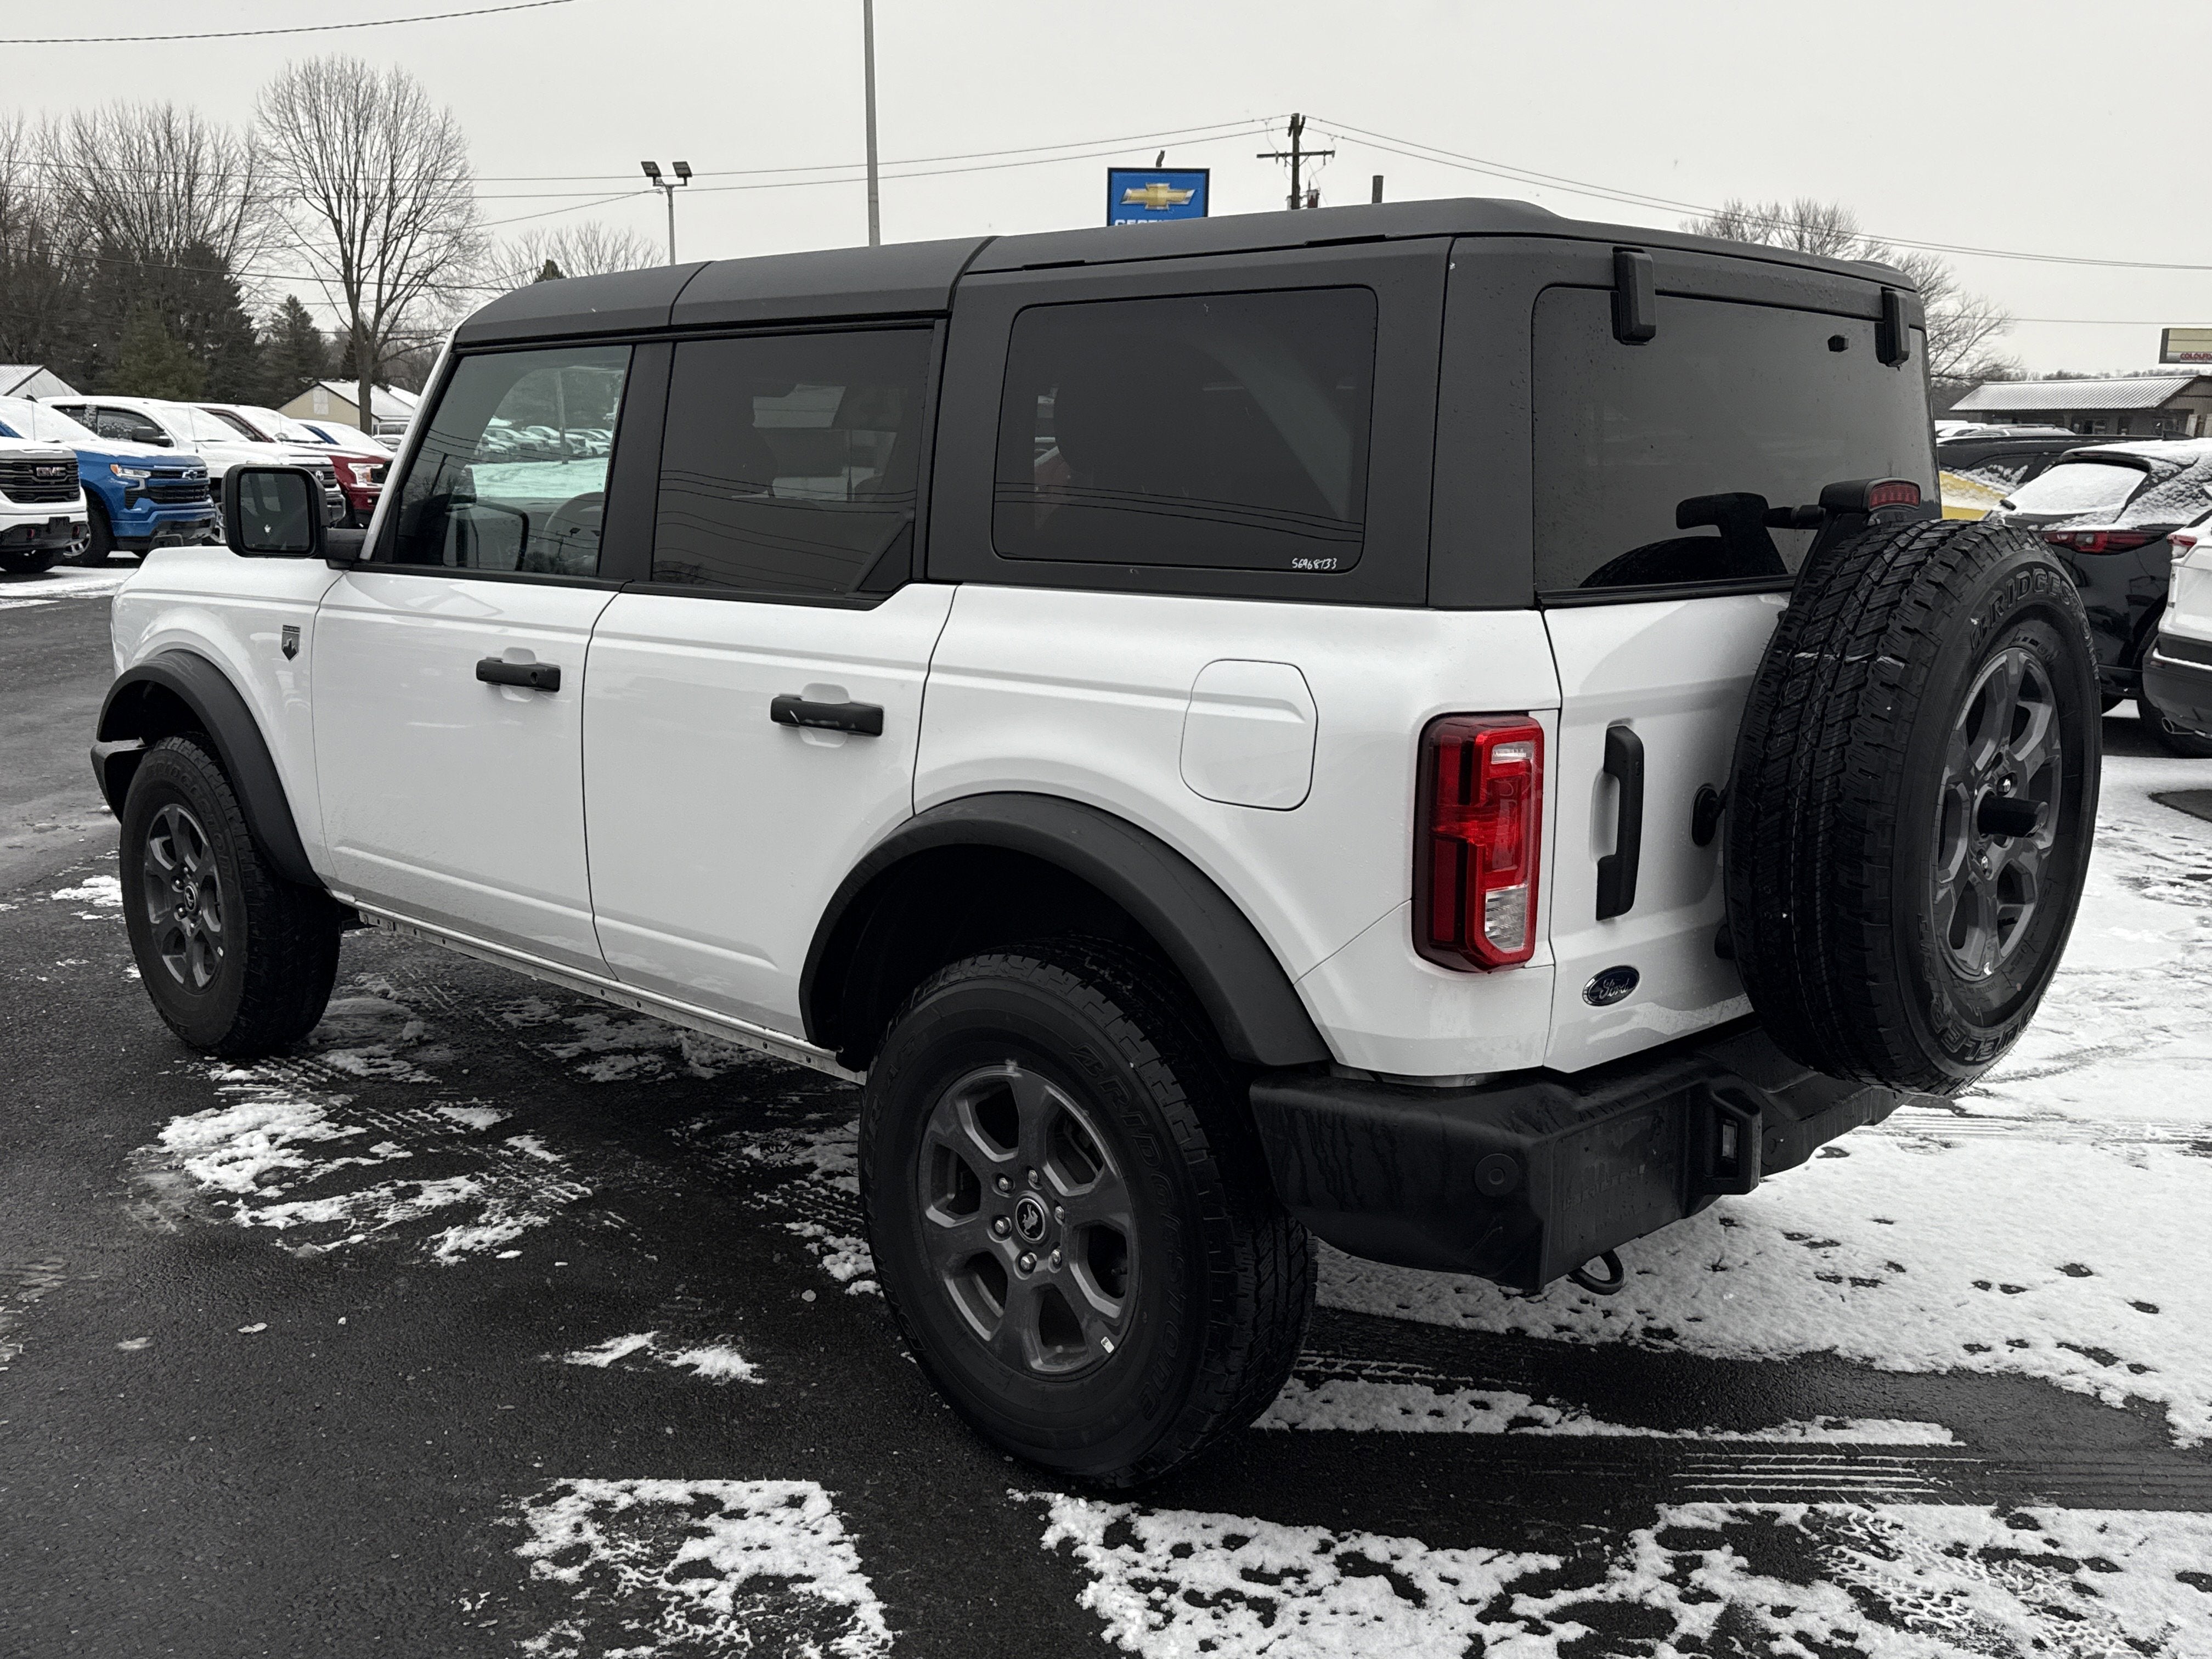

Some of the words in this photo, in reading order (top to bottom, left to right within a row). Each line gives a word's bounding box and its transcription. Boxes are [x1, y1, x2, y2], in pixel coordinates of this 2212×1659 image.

[36, 467, 66, 476] GMC
[1599, 978, 1630, 1000] Ford
[1068, 1043, 1188, 1421] BRIDGESTONE
